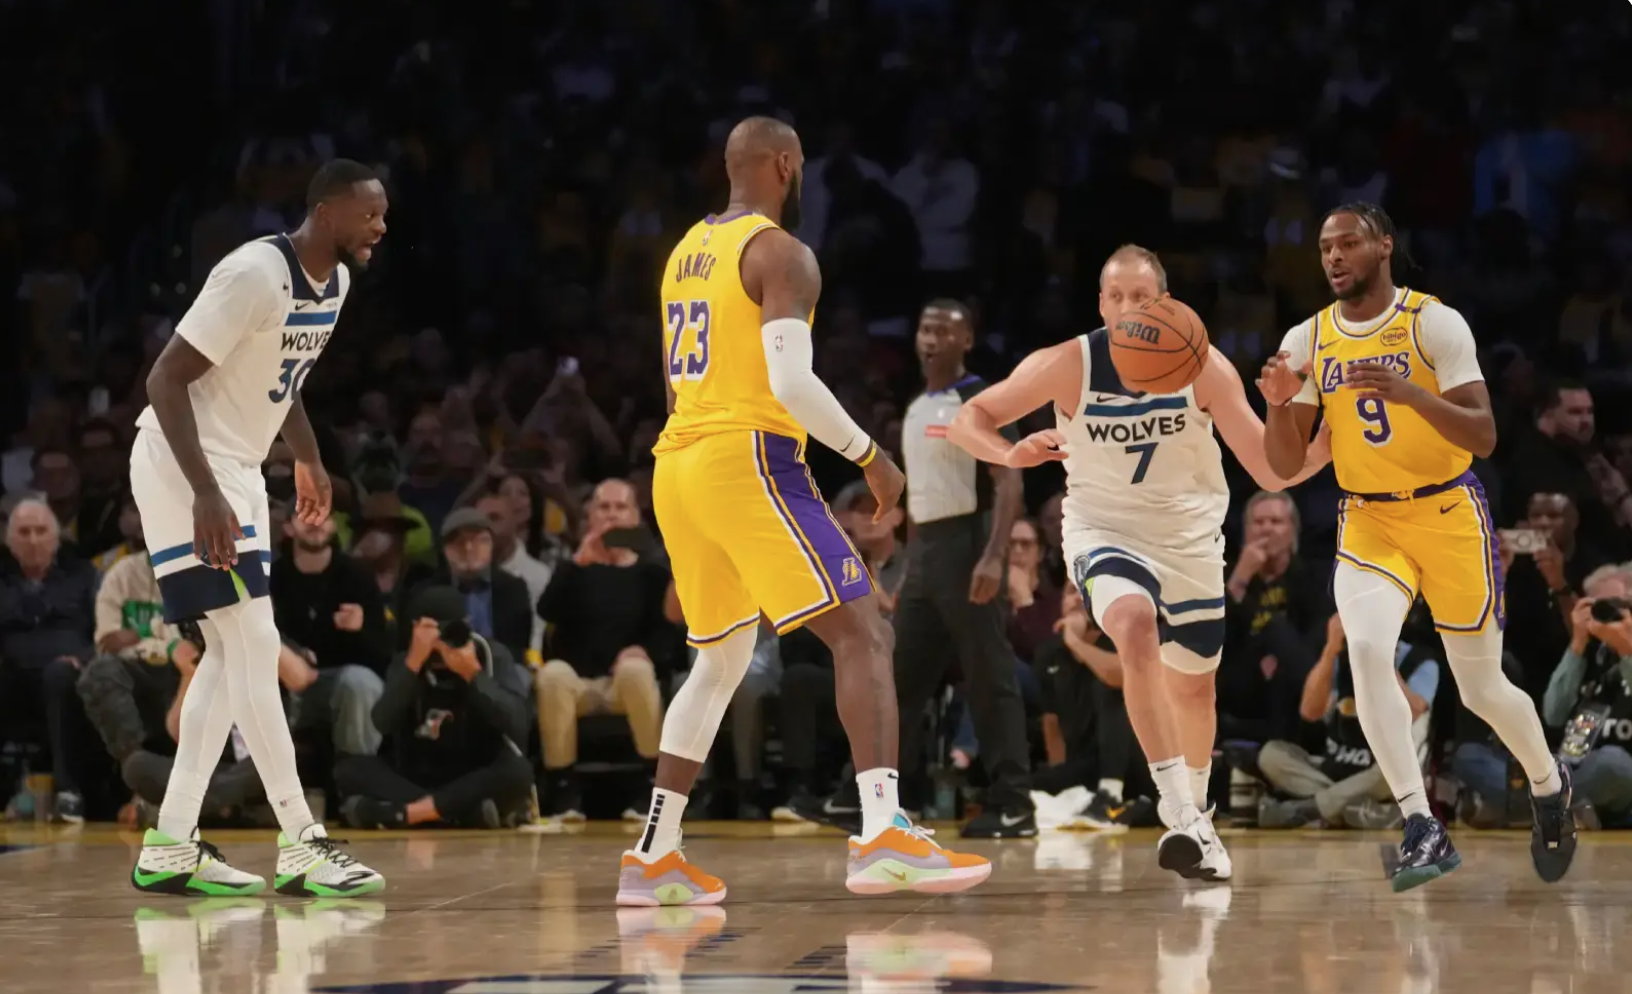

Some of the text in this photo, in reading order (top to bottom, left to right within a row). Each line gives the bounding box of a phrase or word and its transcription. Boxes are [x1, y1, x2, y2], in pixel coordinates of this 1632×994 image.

[676, 252, 717, 283] JAMES
[280, 331, 332, 351] WOLVE
[666, 300, 711, 382] 23
[1322, 351, 1412, 394] LAS
[1086, 413, 1187, 443] WOLVES
[1355, 397, 1394, 447] 9
[1125, 442, 1159, 485] 7
